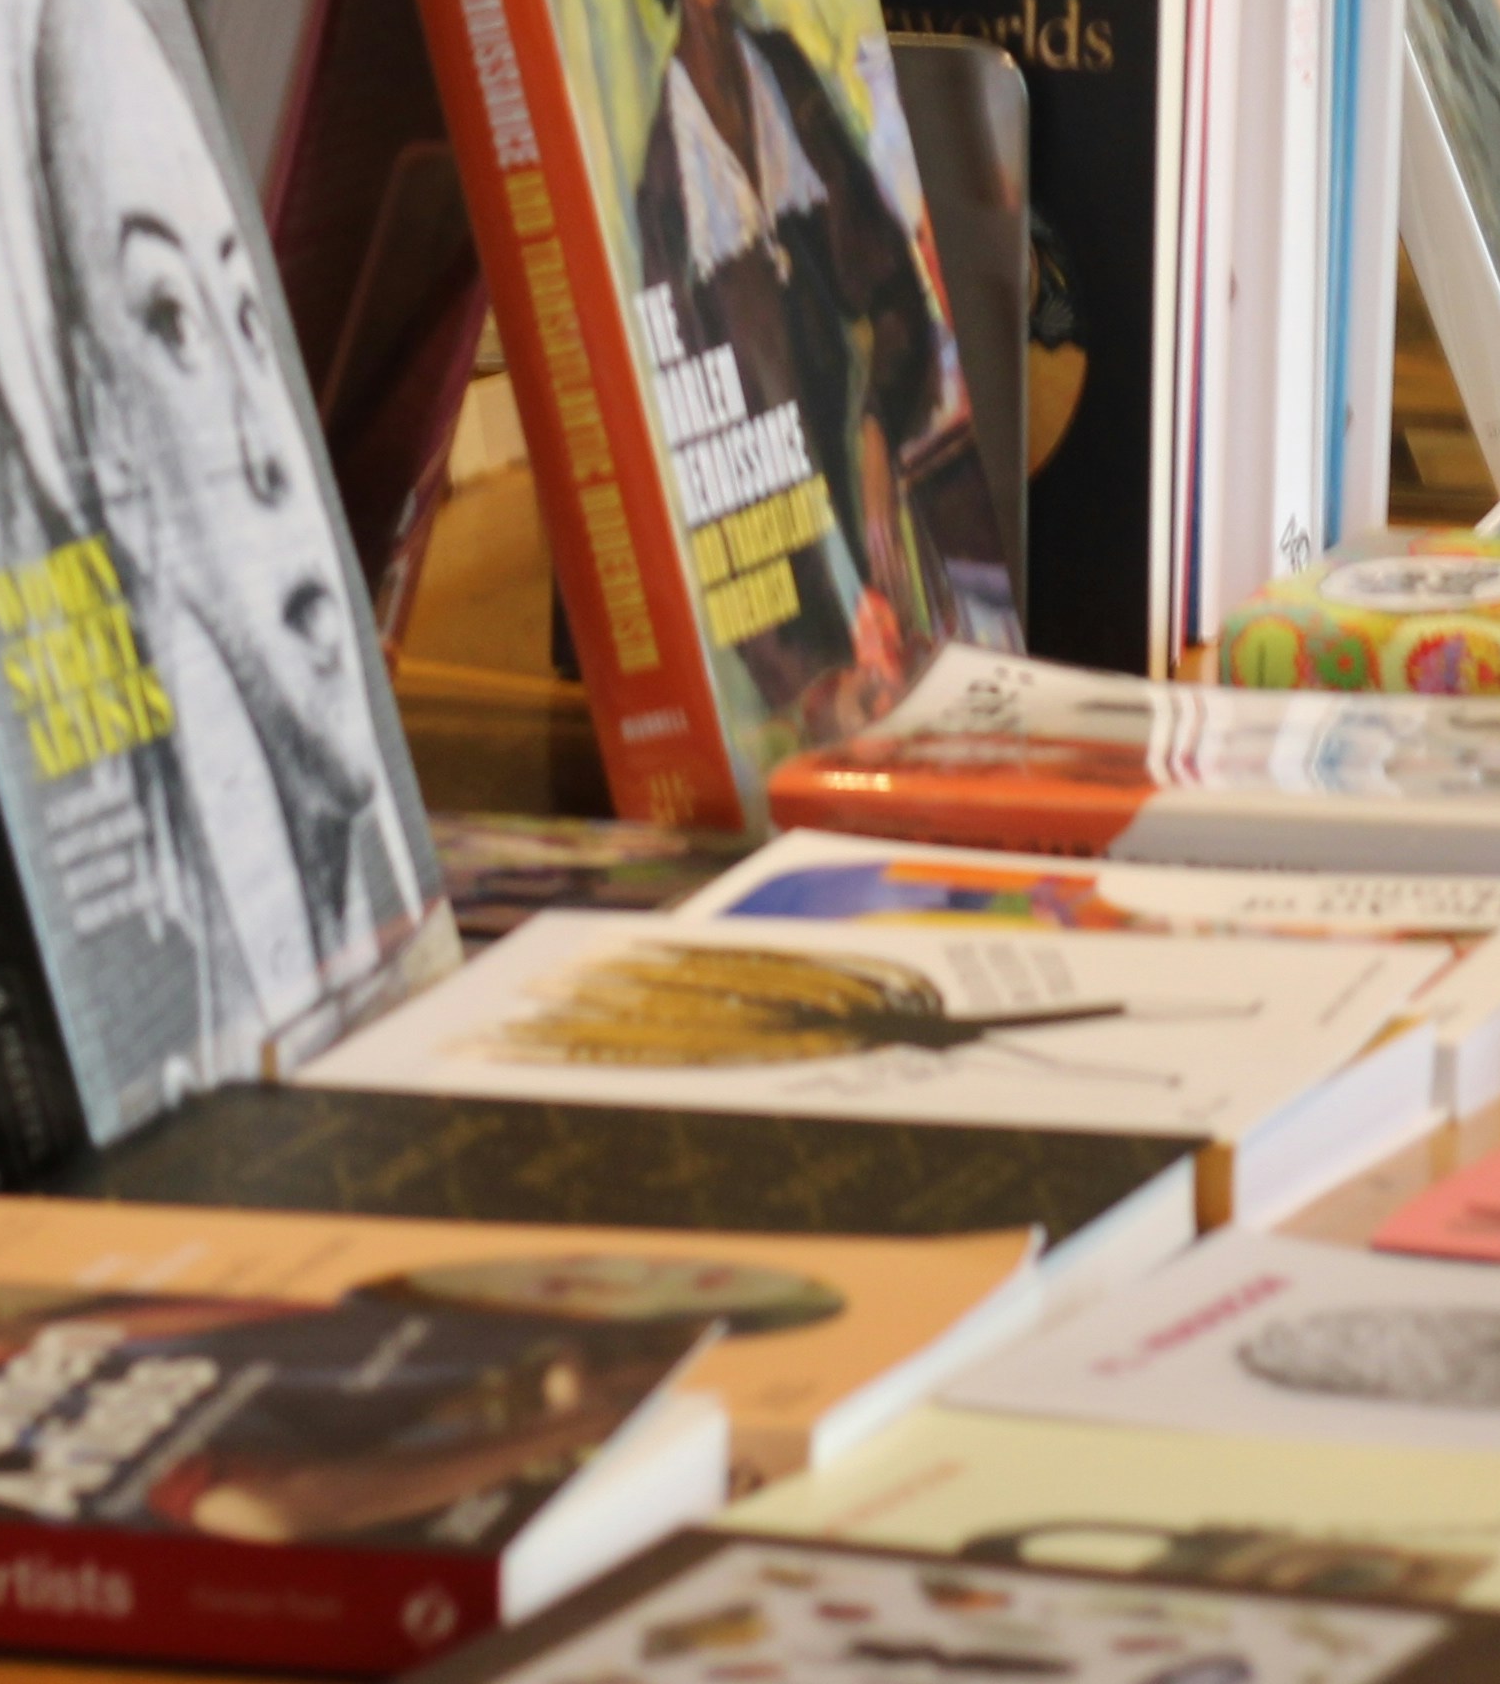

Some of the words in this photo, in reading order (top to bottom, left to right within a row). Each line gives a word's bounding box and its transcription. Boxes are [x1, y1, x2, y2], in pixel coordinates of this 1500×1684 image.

[503, 167, 556, 239] AND
[520, 237, 613, 484] TRANSATLANTIC
[634, 280, 686, 369] THE
[654, 342, 748, 449] HARLEM
[670, 399, 815, 529] RENAISSANCE
[574, 478, 662, 676] MODERNISM
[691, 520, 733, 592] AND
[703, 553, 802, 651] MODERNISM
[24, 666, 177, 784] ARTISTS
